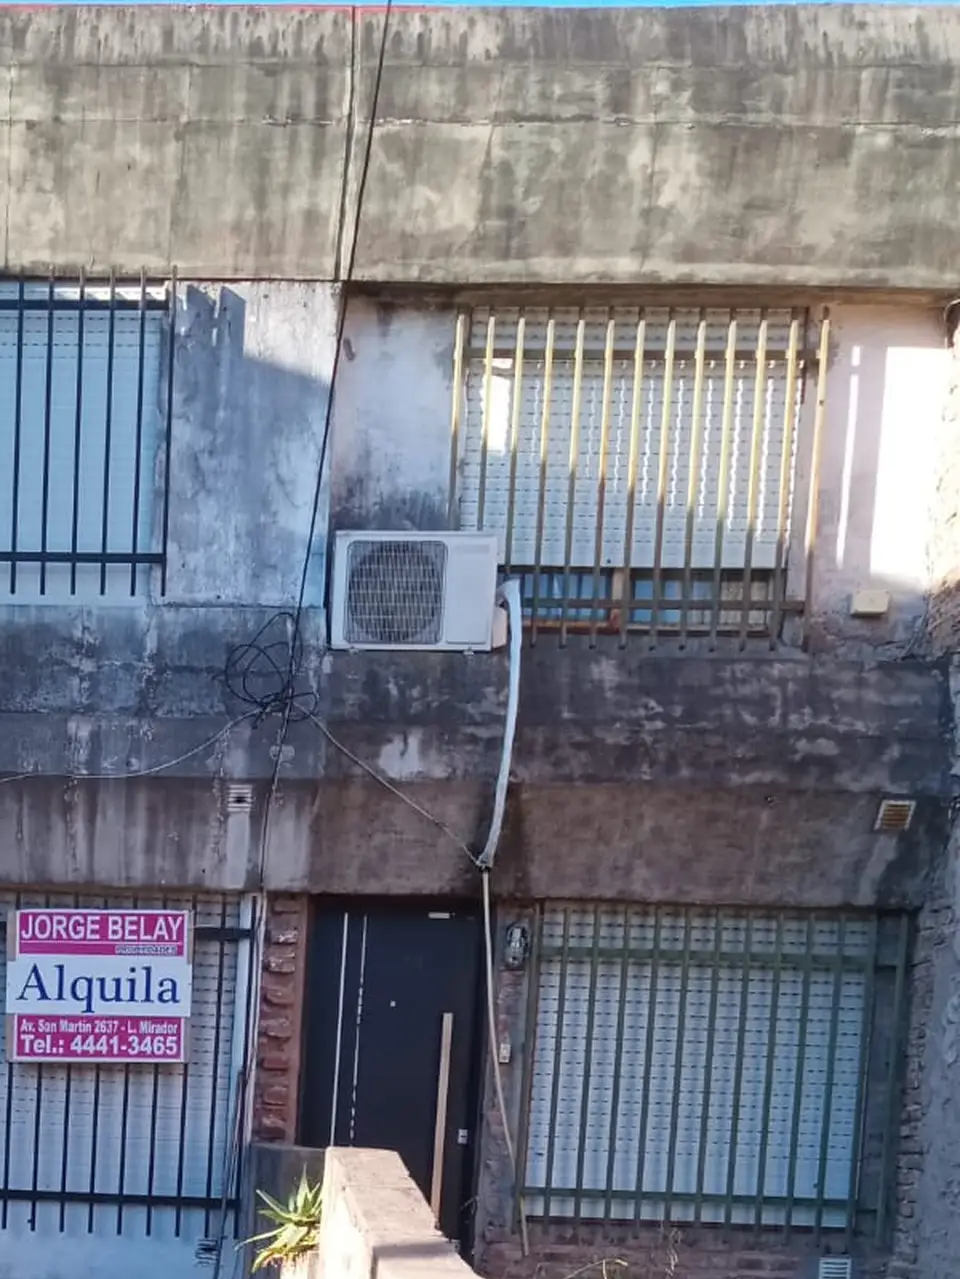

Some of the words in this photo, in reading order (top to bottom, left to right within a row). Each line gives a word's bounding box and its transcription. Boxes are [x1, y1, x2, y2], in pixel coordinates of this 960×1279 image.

[21, 914, 100, 940] JORGE
[107, 915, 183, 941] BELAY
[15, 963, 181, 1014] Alquila
[20, 1019, 35, 1033] Av.
[38, 1019, 57, 1033] San
[94, 1020, 119, 1034] 2637
[127, 1021, 137, 1034] L.
[139, 1020, 178, 1035] Mirador
[20, 1034, 65, 1054] Tel.:
[70, 1035, 178, 1056] 4441-3465
